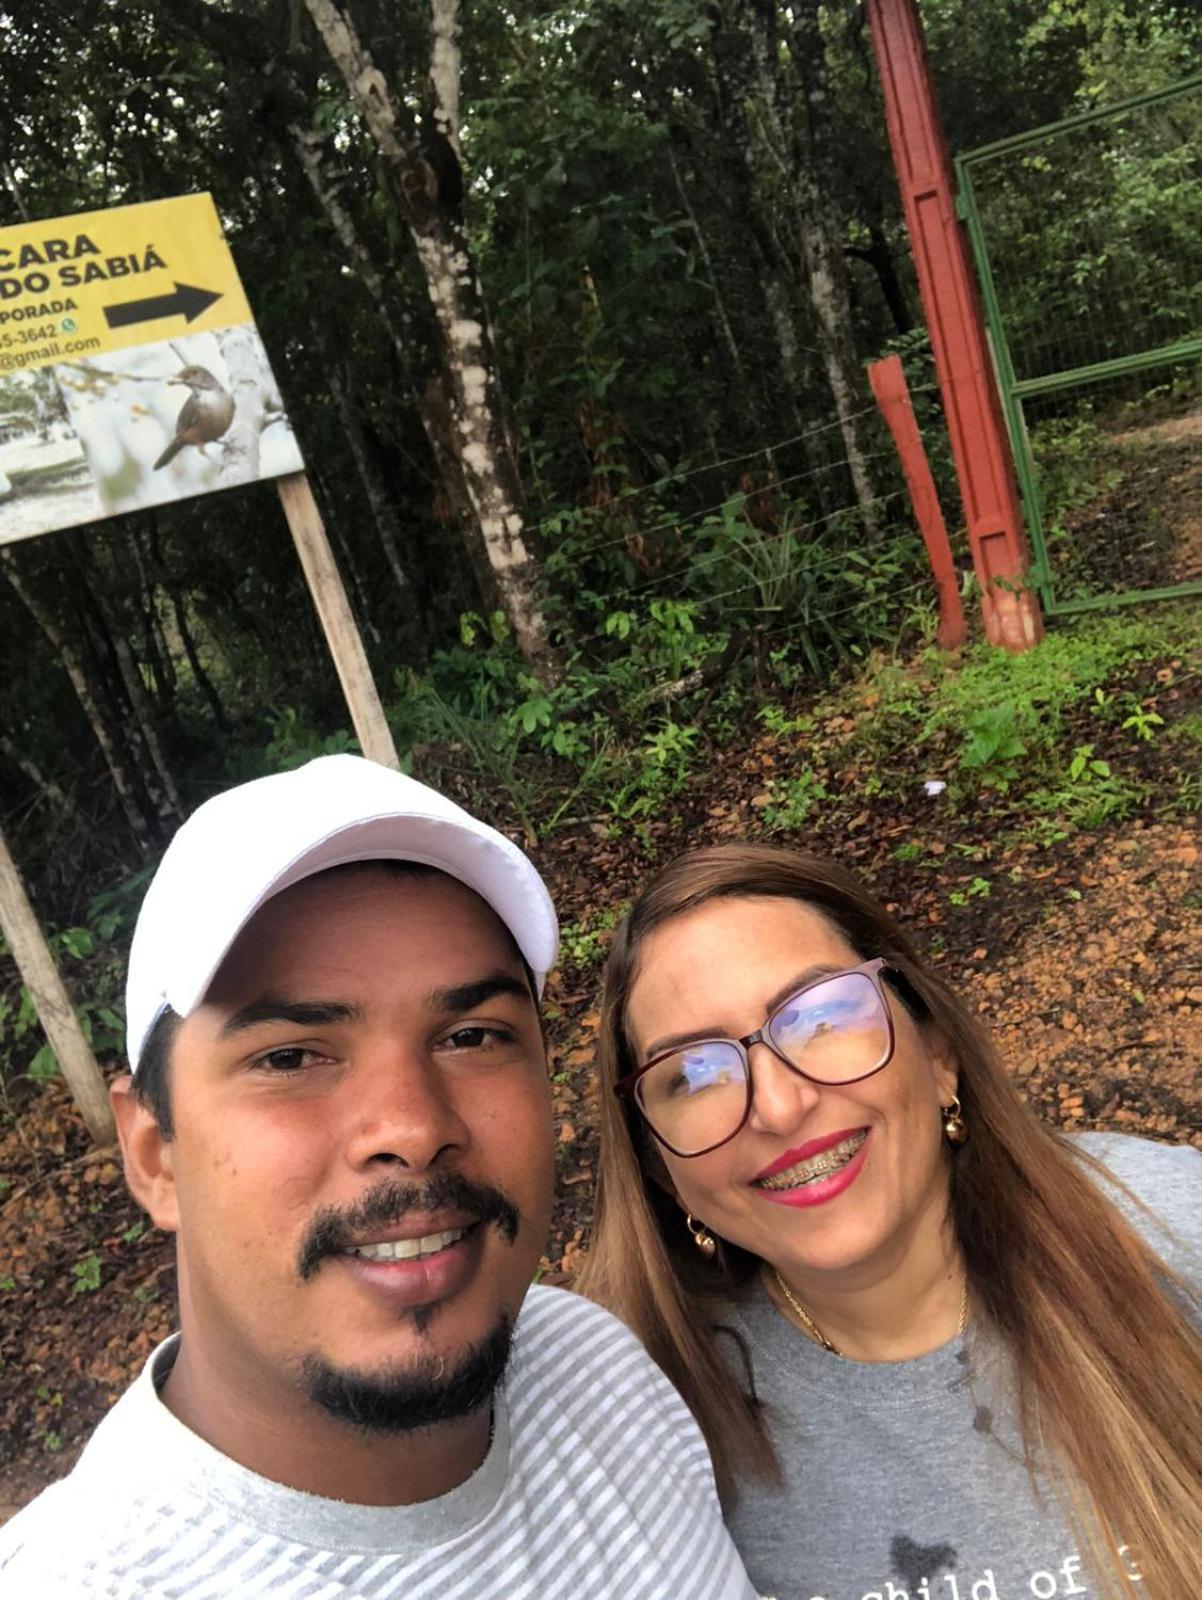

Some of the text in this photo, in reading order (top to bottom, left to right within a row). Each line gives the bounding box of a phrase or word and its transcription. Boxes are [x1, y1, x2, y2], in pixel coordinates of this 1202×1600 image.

[0, 244, 167, 299] DO SABIÁ
[0, 323, 58, 349] 5-3642
[1030, 1555, 1087, 1599] of
